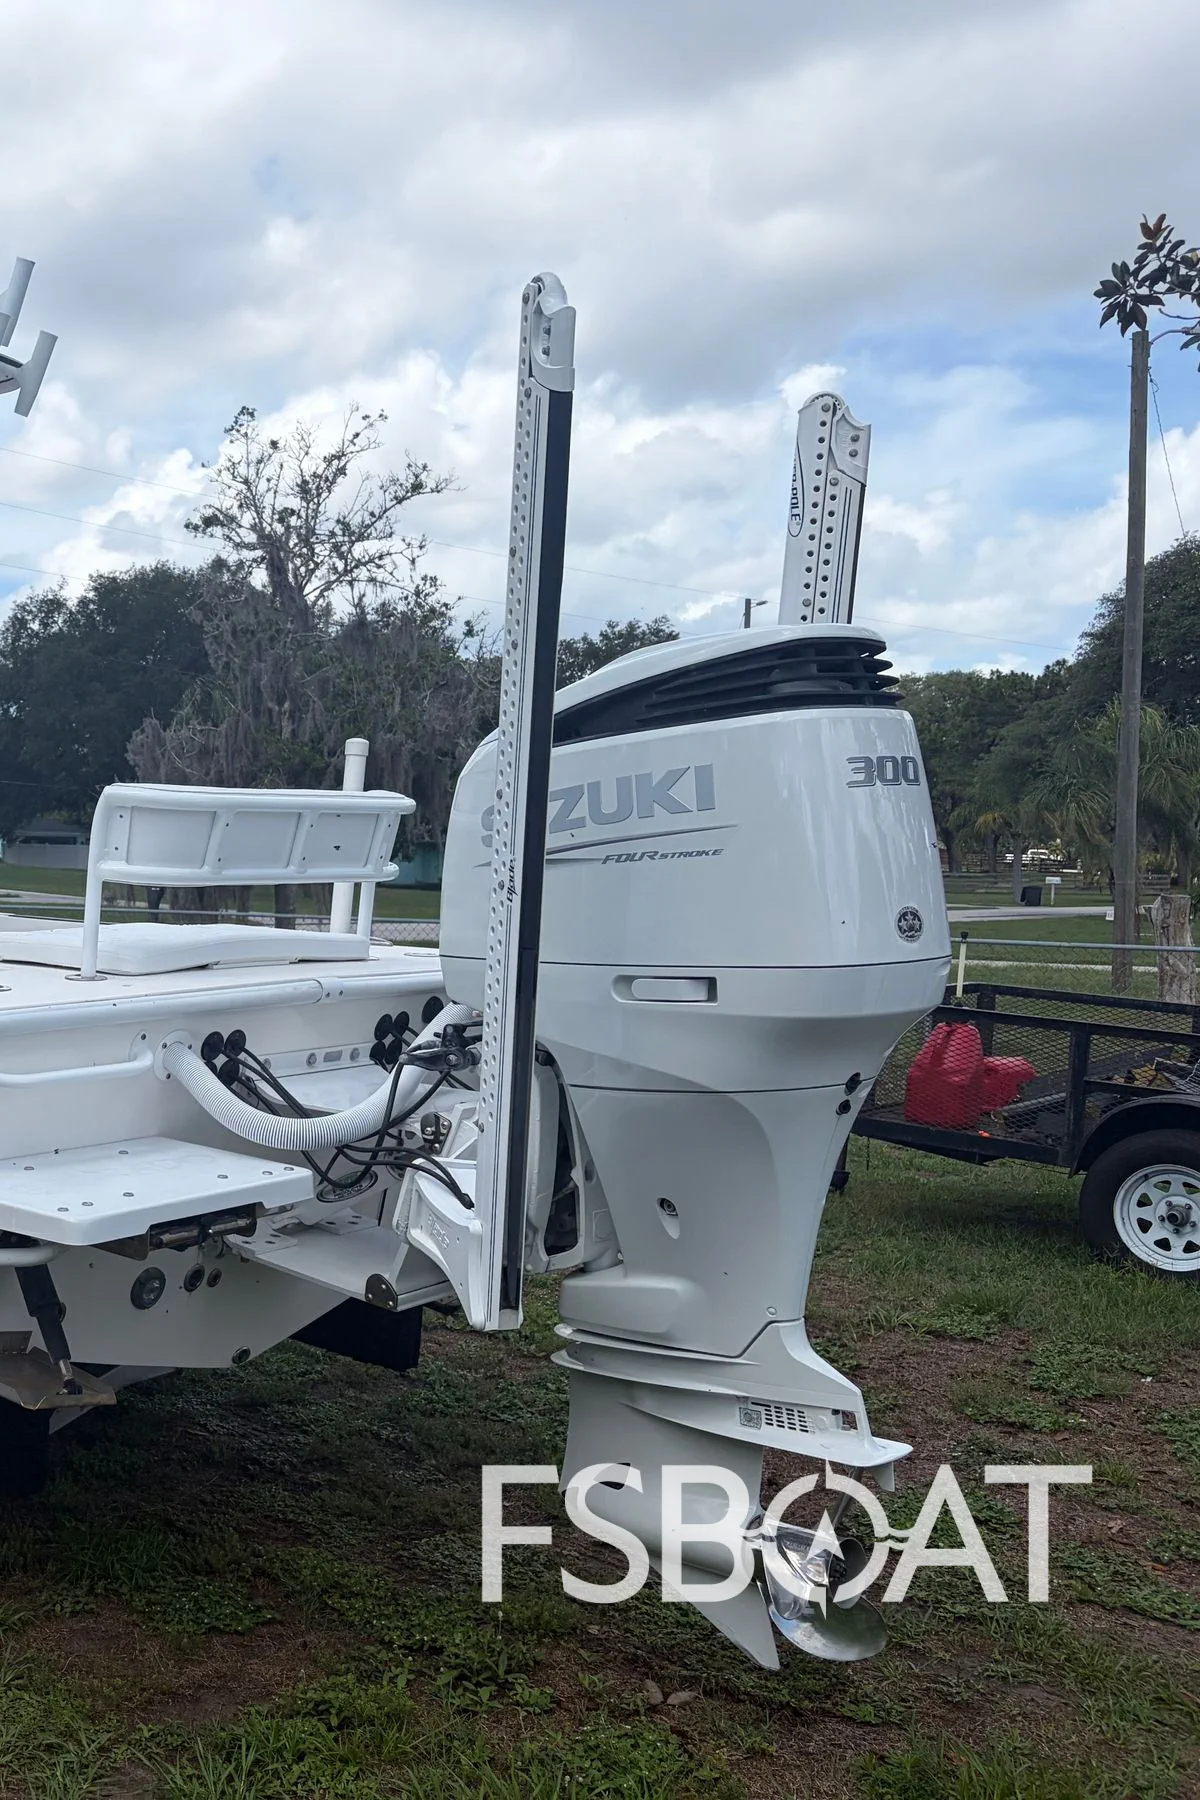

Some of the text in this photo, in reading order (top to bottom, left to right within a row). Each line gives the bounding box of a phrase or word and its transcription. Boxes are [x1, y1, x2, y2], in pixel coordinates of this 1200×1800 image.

[846, 755, 921, 788] 300
[601, 848, 725, 865] FOUR STROKE
[506, 858, 518, 903] Blade
